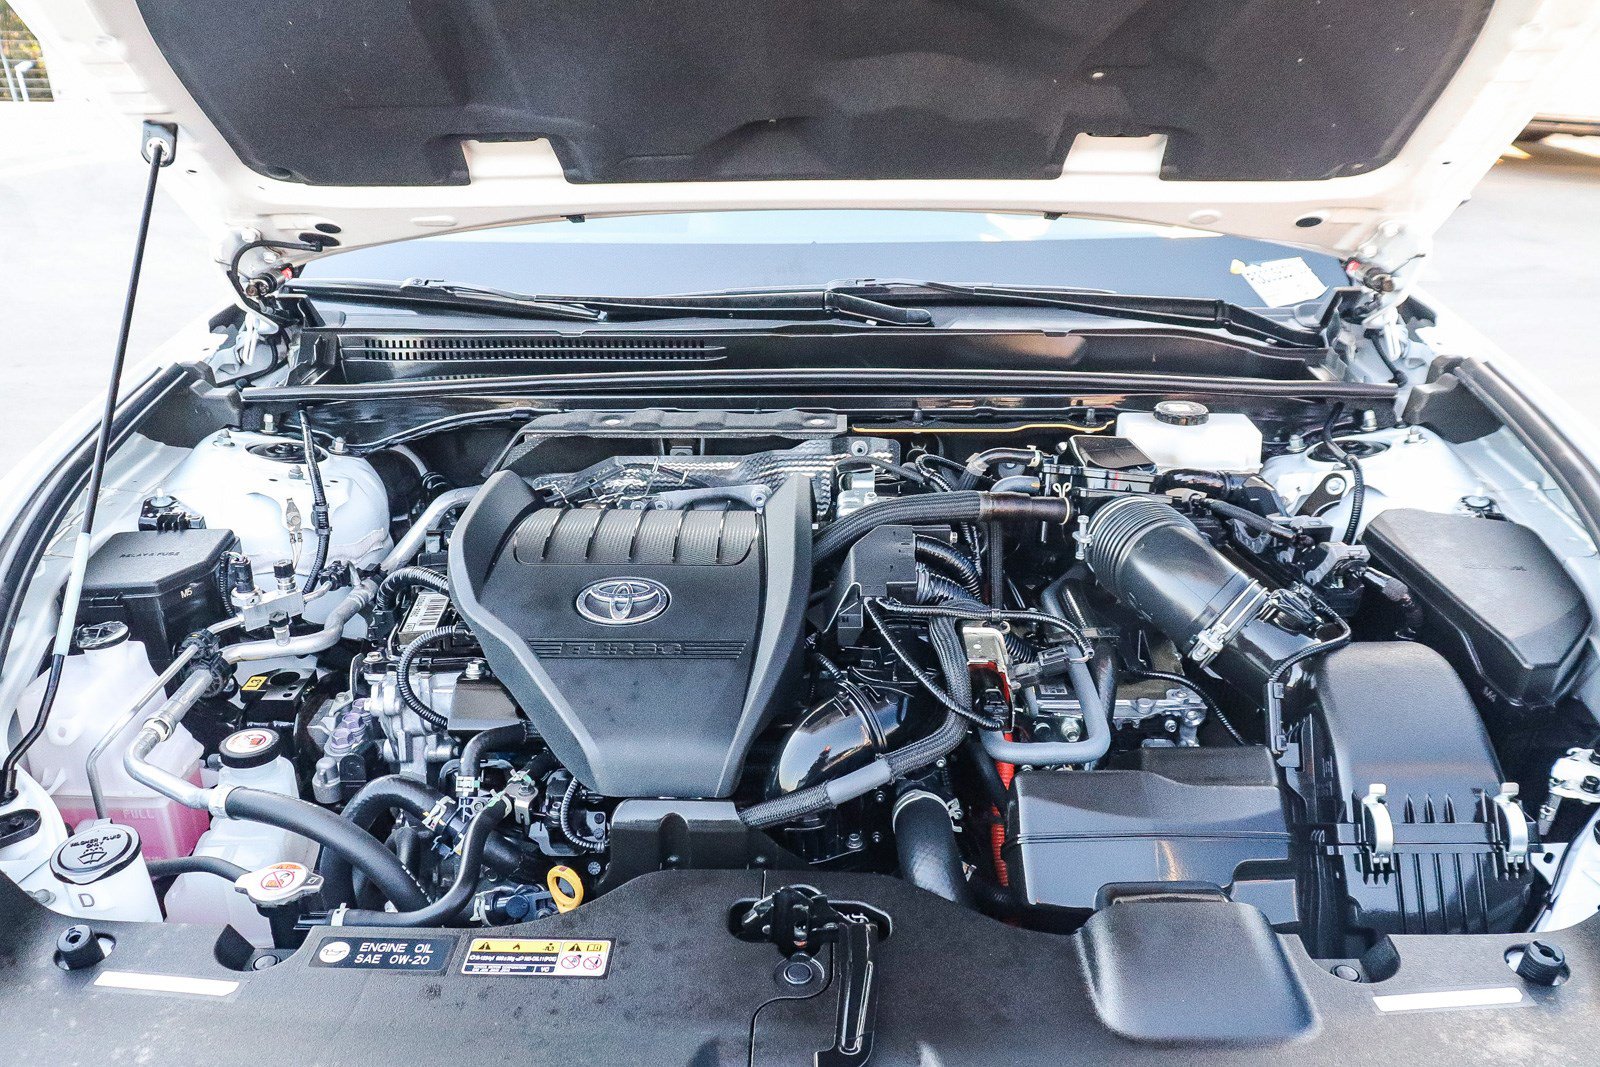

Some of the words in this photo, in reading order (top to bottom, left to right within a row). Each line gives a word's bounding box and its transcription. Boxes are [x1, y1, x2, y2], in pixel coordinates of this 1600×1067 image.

[78, 892, 95, 908] D
[359, 942, 408, 953] ENGINE
[414, 943, 434, 954] OIL
[354, 953, 382, 964] SAE
[388, 955, 430, 965] 0W-20
